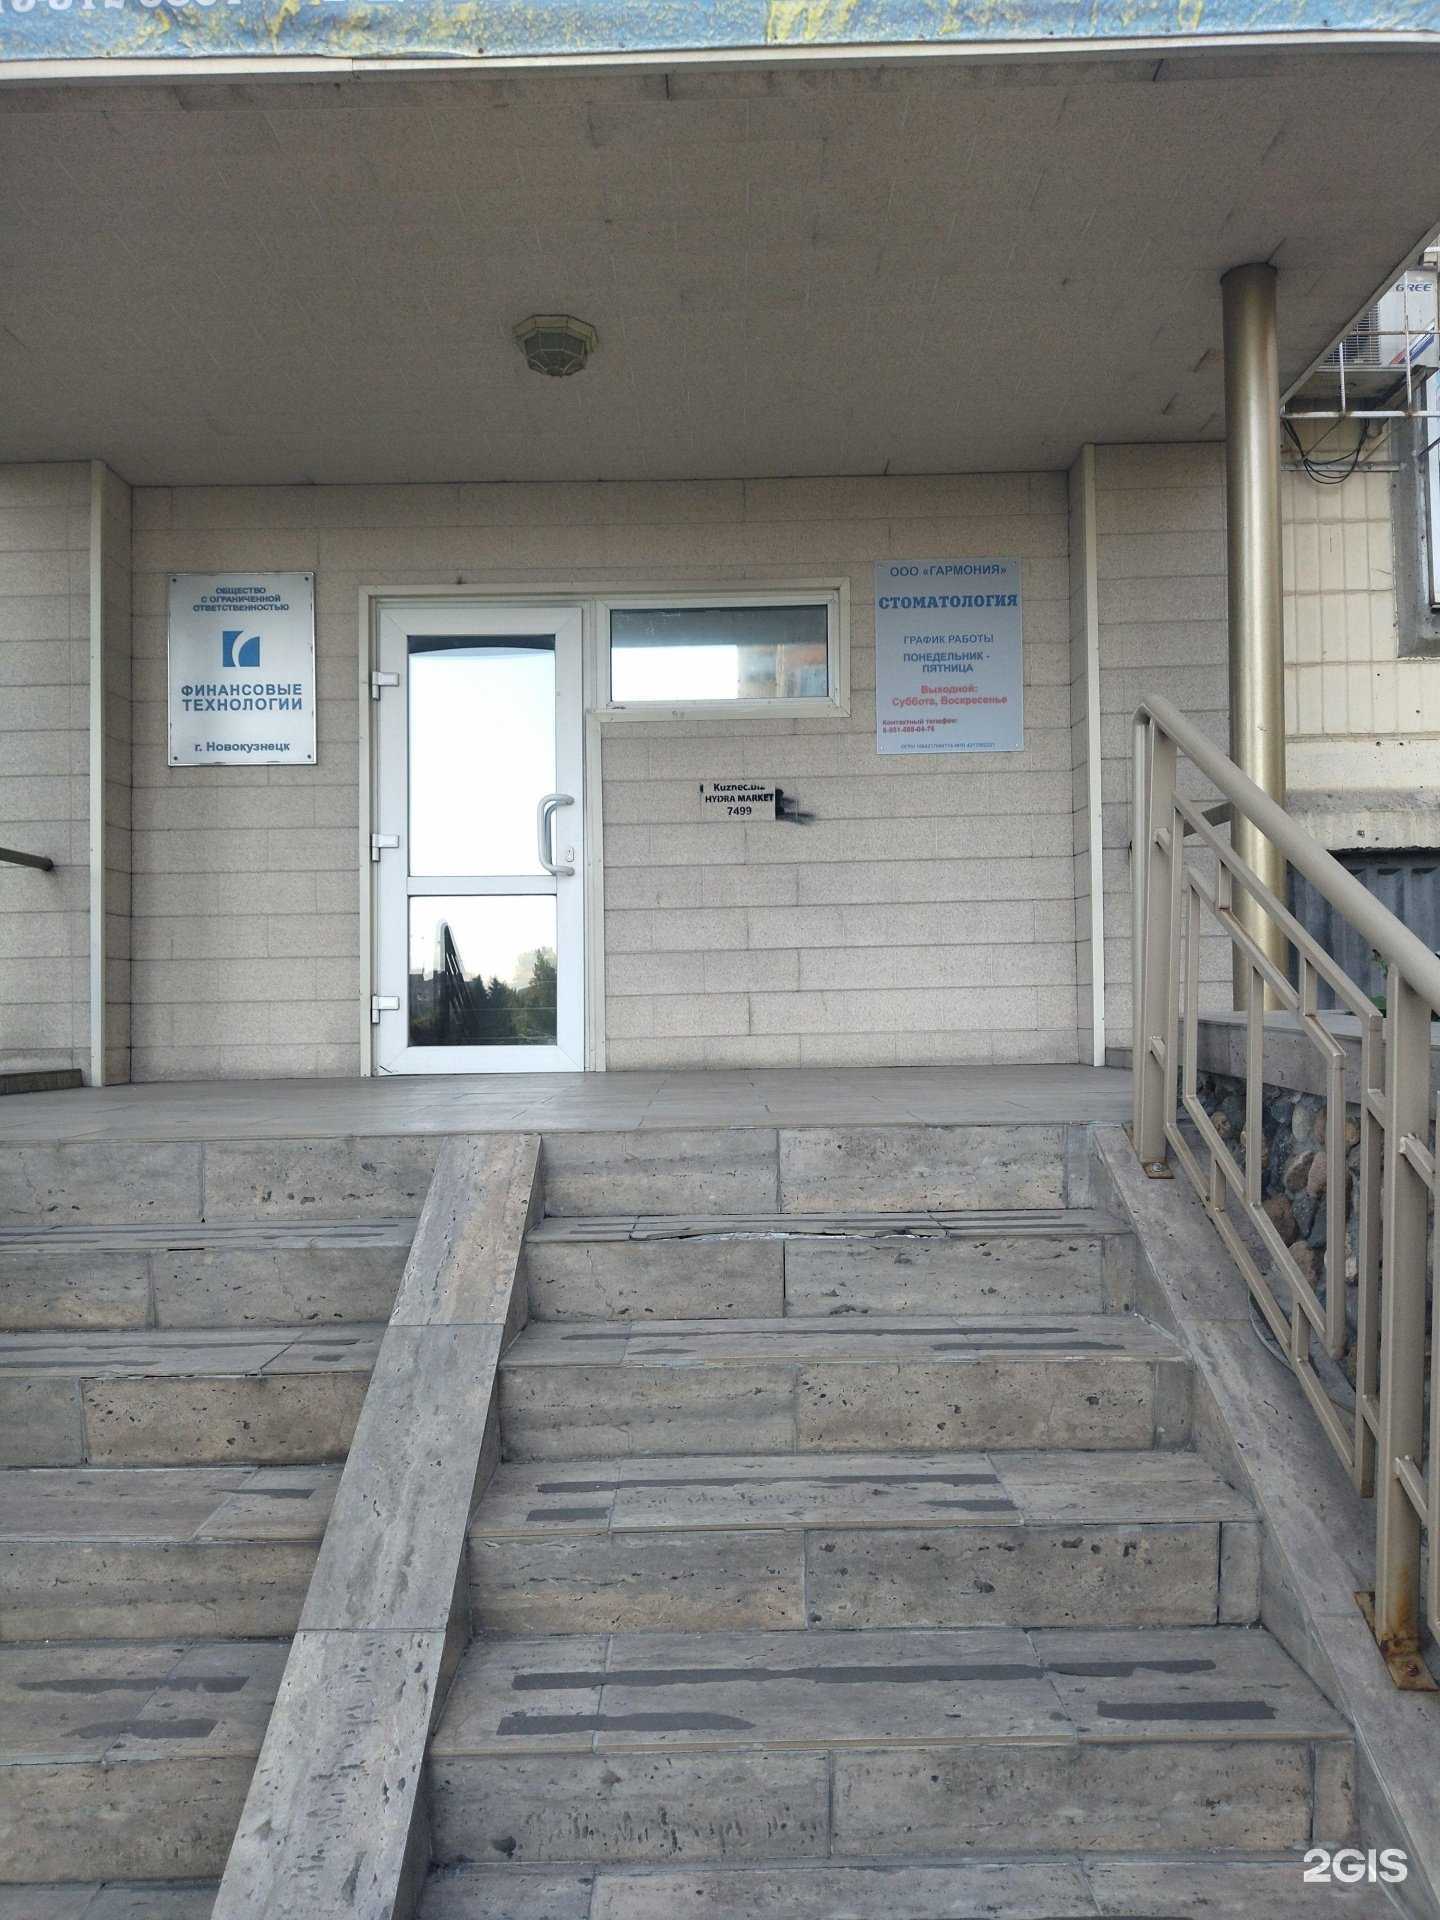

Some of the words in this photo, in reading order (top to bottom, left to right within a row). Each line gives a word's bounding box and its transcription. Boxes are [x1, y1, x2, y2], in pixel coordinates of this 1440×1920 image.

[1395, 283, 1433, 292] GREE
[890, 566, 919, 577] ООО
[923, 564, 1007, 576] «ГАРМОНИЯ»
[209, 594, 281, 603] ОГРАНИЧЕННОЙ
[879, 594, 1018, 609] СТОМАТОЛОГИЯ
[904, 635, 945, 645] ГРАФИК
[948, 634, 994, 644] РАБОТЫ
[903, 652, 984, 663] ПОНЕДЕЛЬНИК
[922, 664, 974, 674] ПЯТНИЦА
[181, 683, 303, 696] ФИНАНСОВЫЕ
[921, 685, 978, 694] Выходной:
[182, 698, 303, 712] ТЕХНОЛОГИИ
[941, 696, 1008, 705] Воскресенье
[194, 743, 202, 752] г.
[206, 742, 290, 753] Новокузнецк
[705, 795, 735, 803] HYDRA
[737, 793, 774, 802] MARKET
[727, 806, 752, 815] 7499
